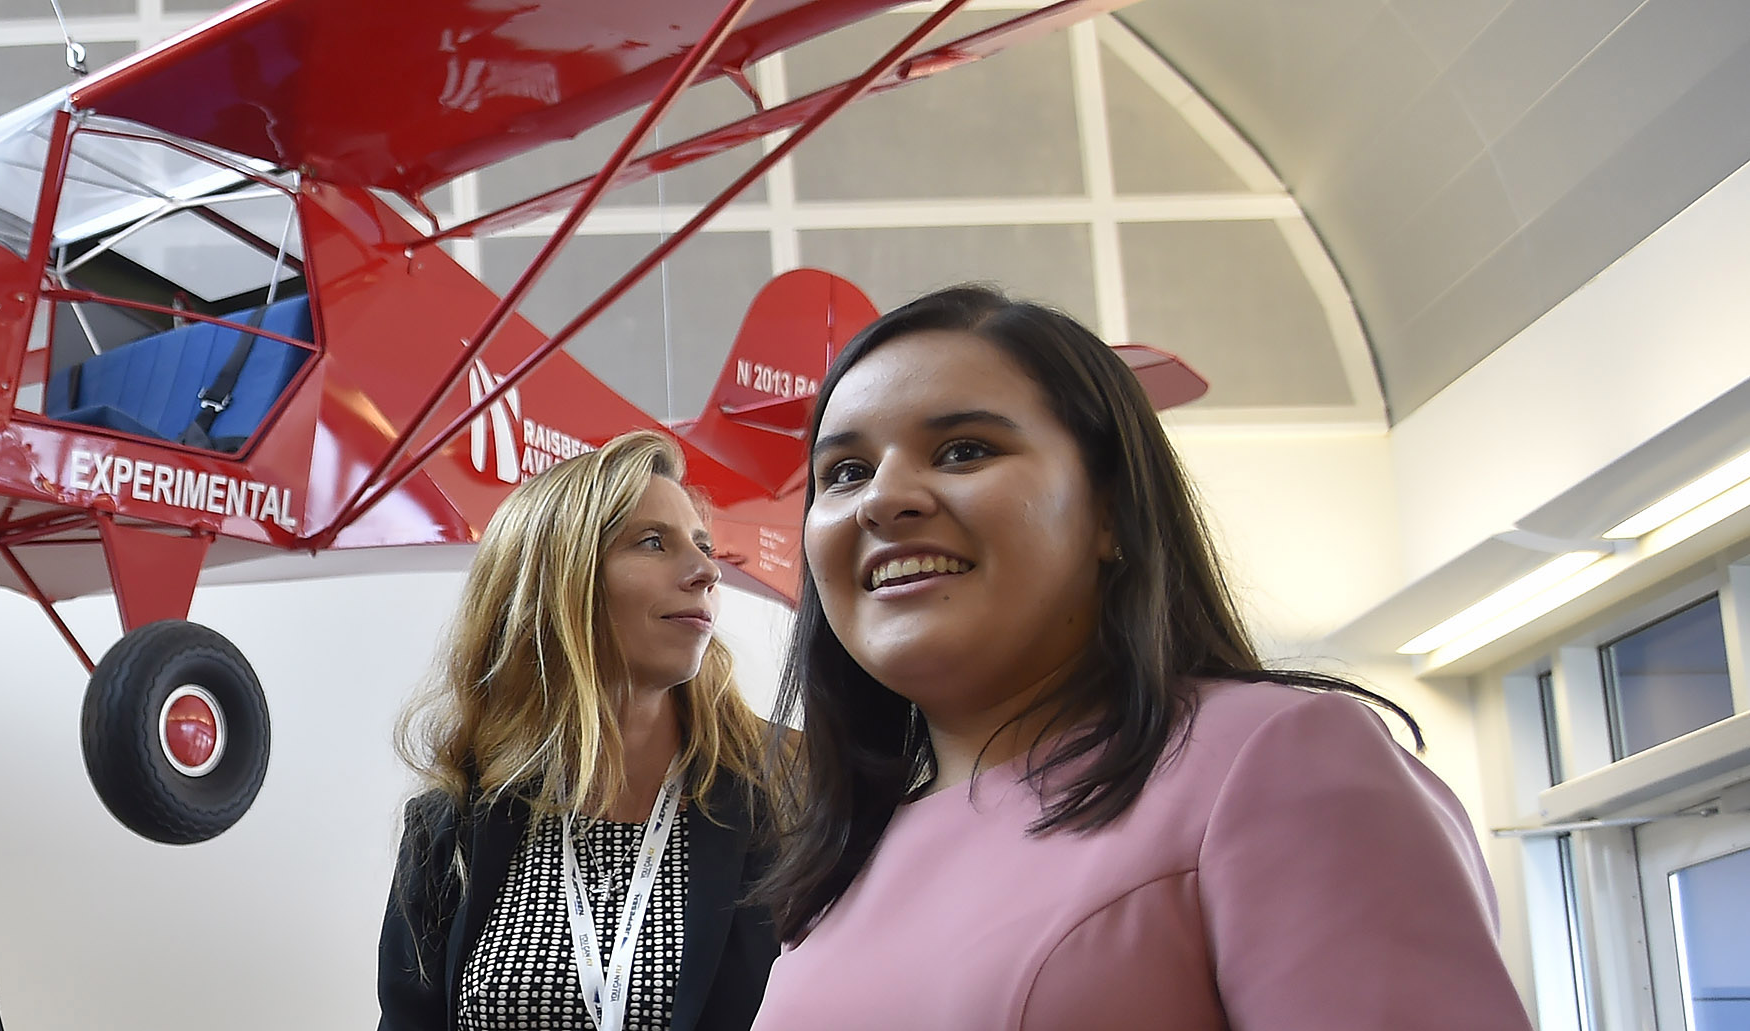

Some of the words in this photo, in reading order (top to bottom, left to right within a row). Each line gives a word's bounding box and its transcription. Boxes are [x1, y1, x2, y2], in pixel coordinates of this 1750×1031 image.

[737, 359, 751, 388] N
[753, 363, 792, 398] 2013
[71, 450, 297, 528] EXPERIMENTAL
